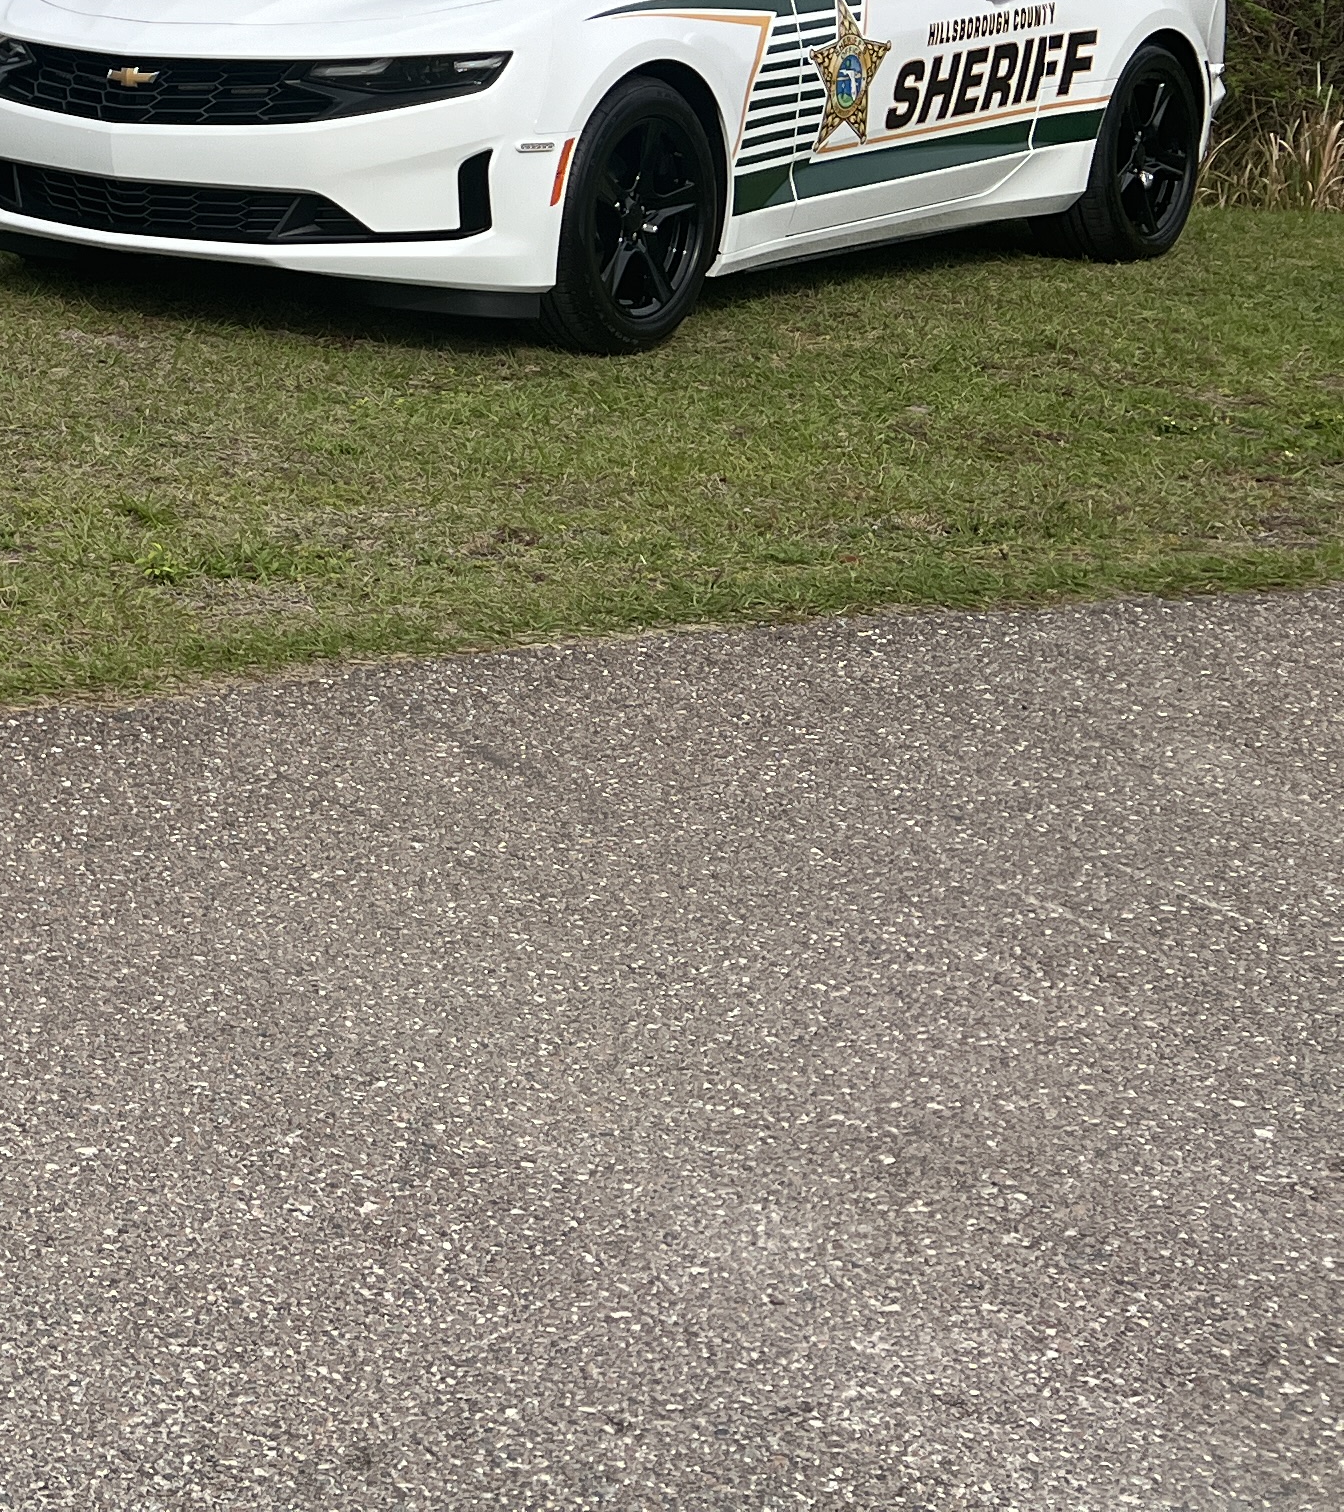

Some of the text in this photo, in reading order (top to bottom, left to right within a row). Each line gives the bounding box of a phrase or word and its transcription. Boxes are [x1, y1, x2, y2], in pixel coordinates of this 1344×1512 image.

[927, 2, 1056, 47] HILLSBOROUGH COUNTY
[885, 29, 1098, 130] SHERIFF
